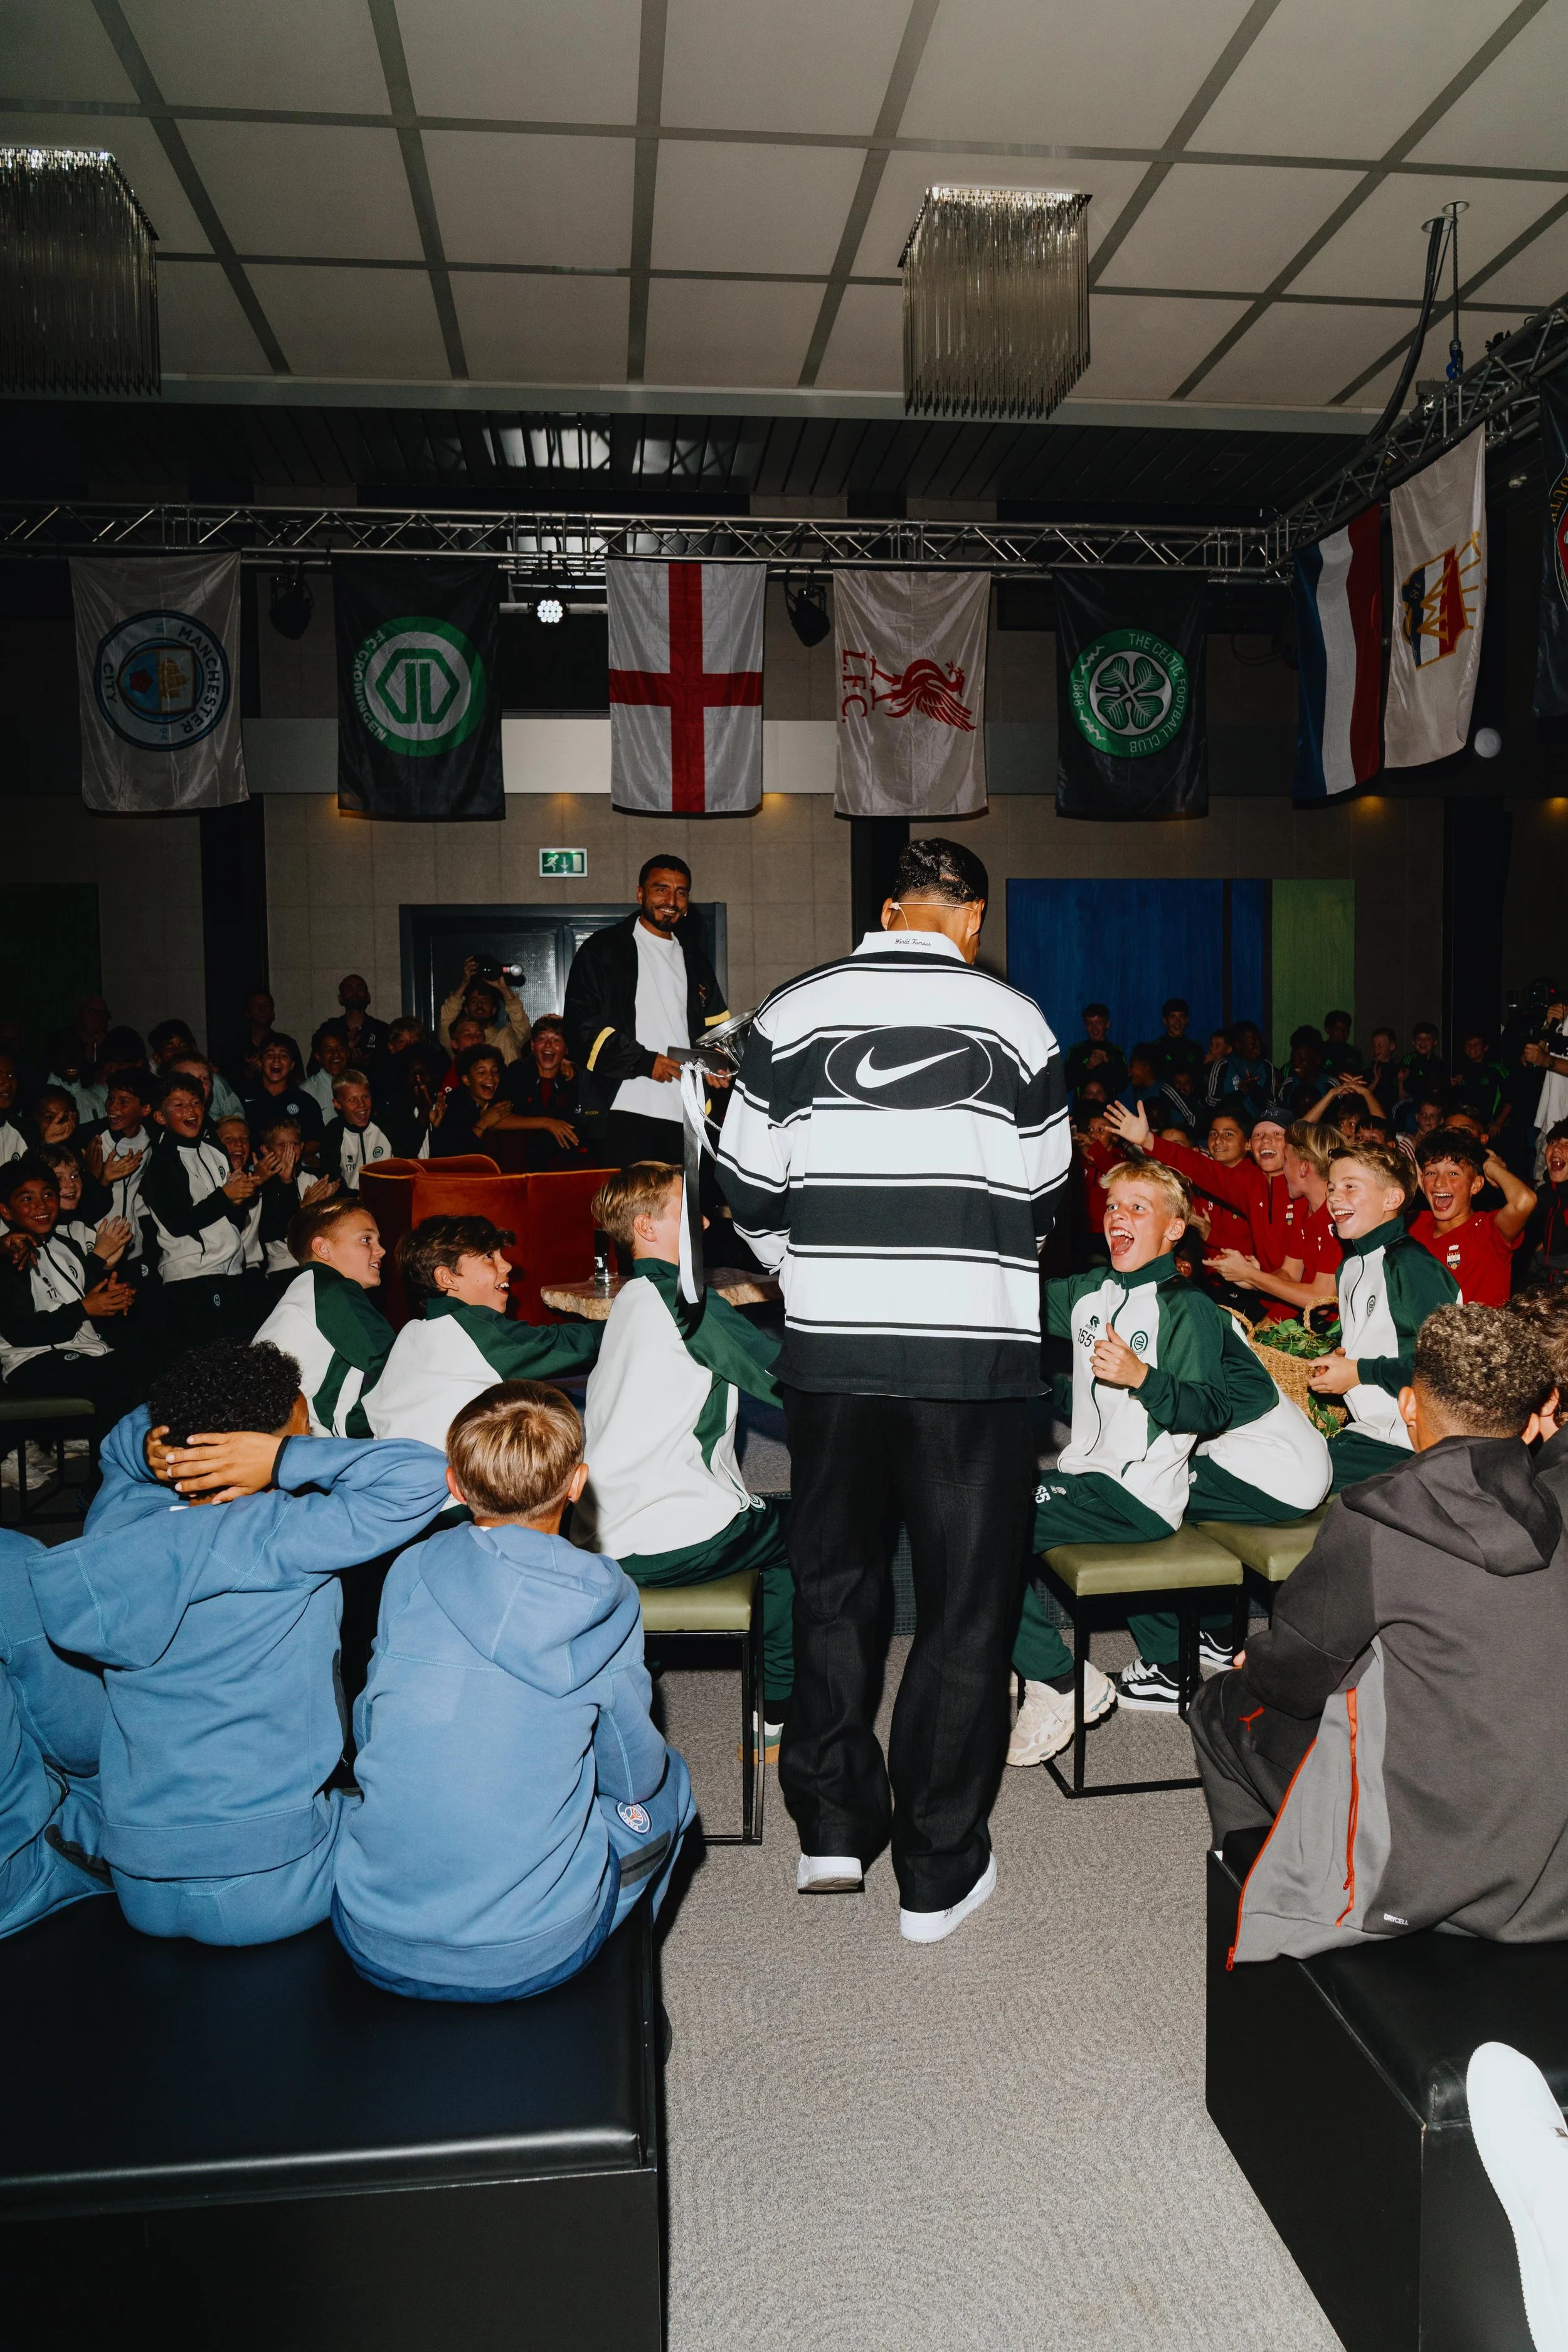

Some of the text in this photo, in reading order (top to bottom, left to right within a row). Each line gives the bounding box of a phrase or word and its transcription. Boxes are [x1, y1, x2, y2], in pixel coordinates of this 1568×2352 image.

[103, 662, 118, 704] CITY
[177, 626, 221, 734] MANCHESTER
[352, 630, 388, 742] FC GRONINGEN
[842, 649, 868, 723] L.F.C.
[1073, 679, 1085, 706] 1888
[1129, 634, 1187, 753] THE CELTIC FOOTBALL CLUB
[911, 939, 932, 947] Famous
[1078, 1328, 1096, 1348] 155
[1084, 1323, 1097, 1333] ROBEY
[1384, 1913, 1409, 1925] DRYCELL
